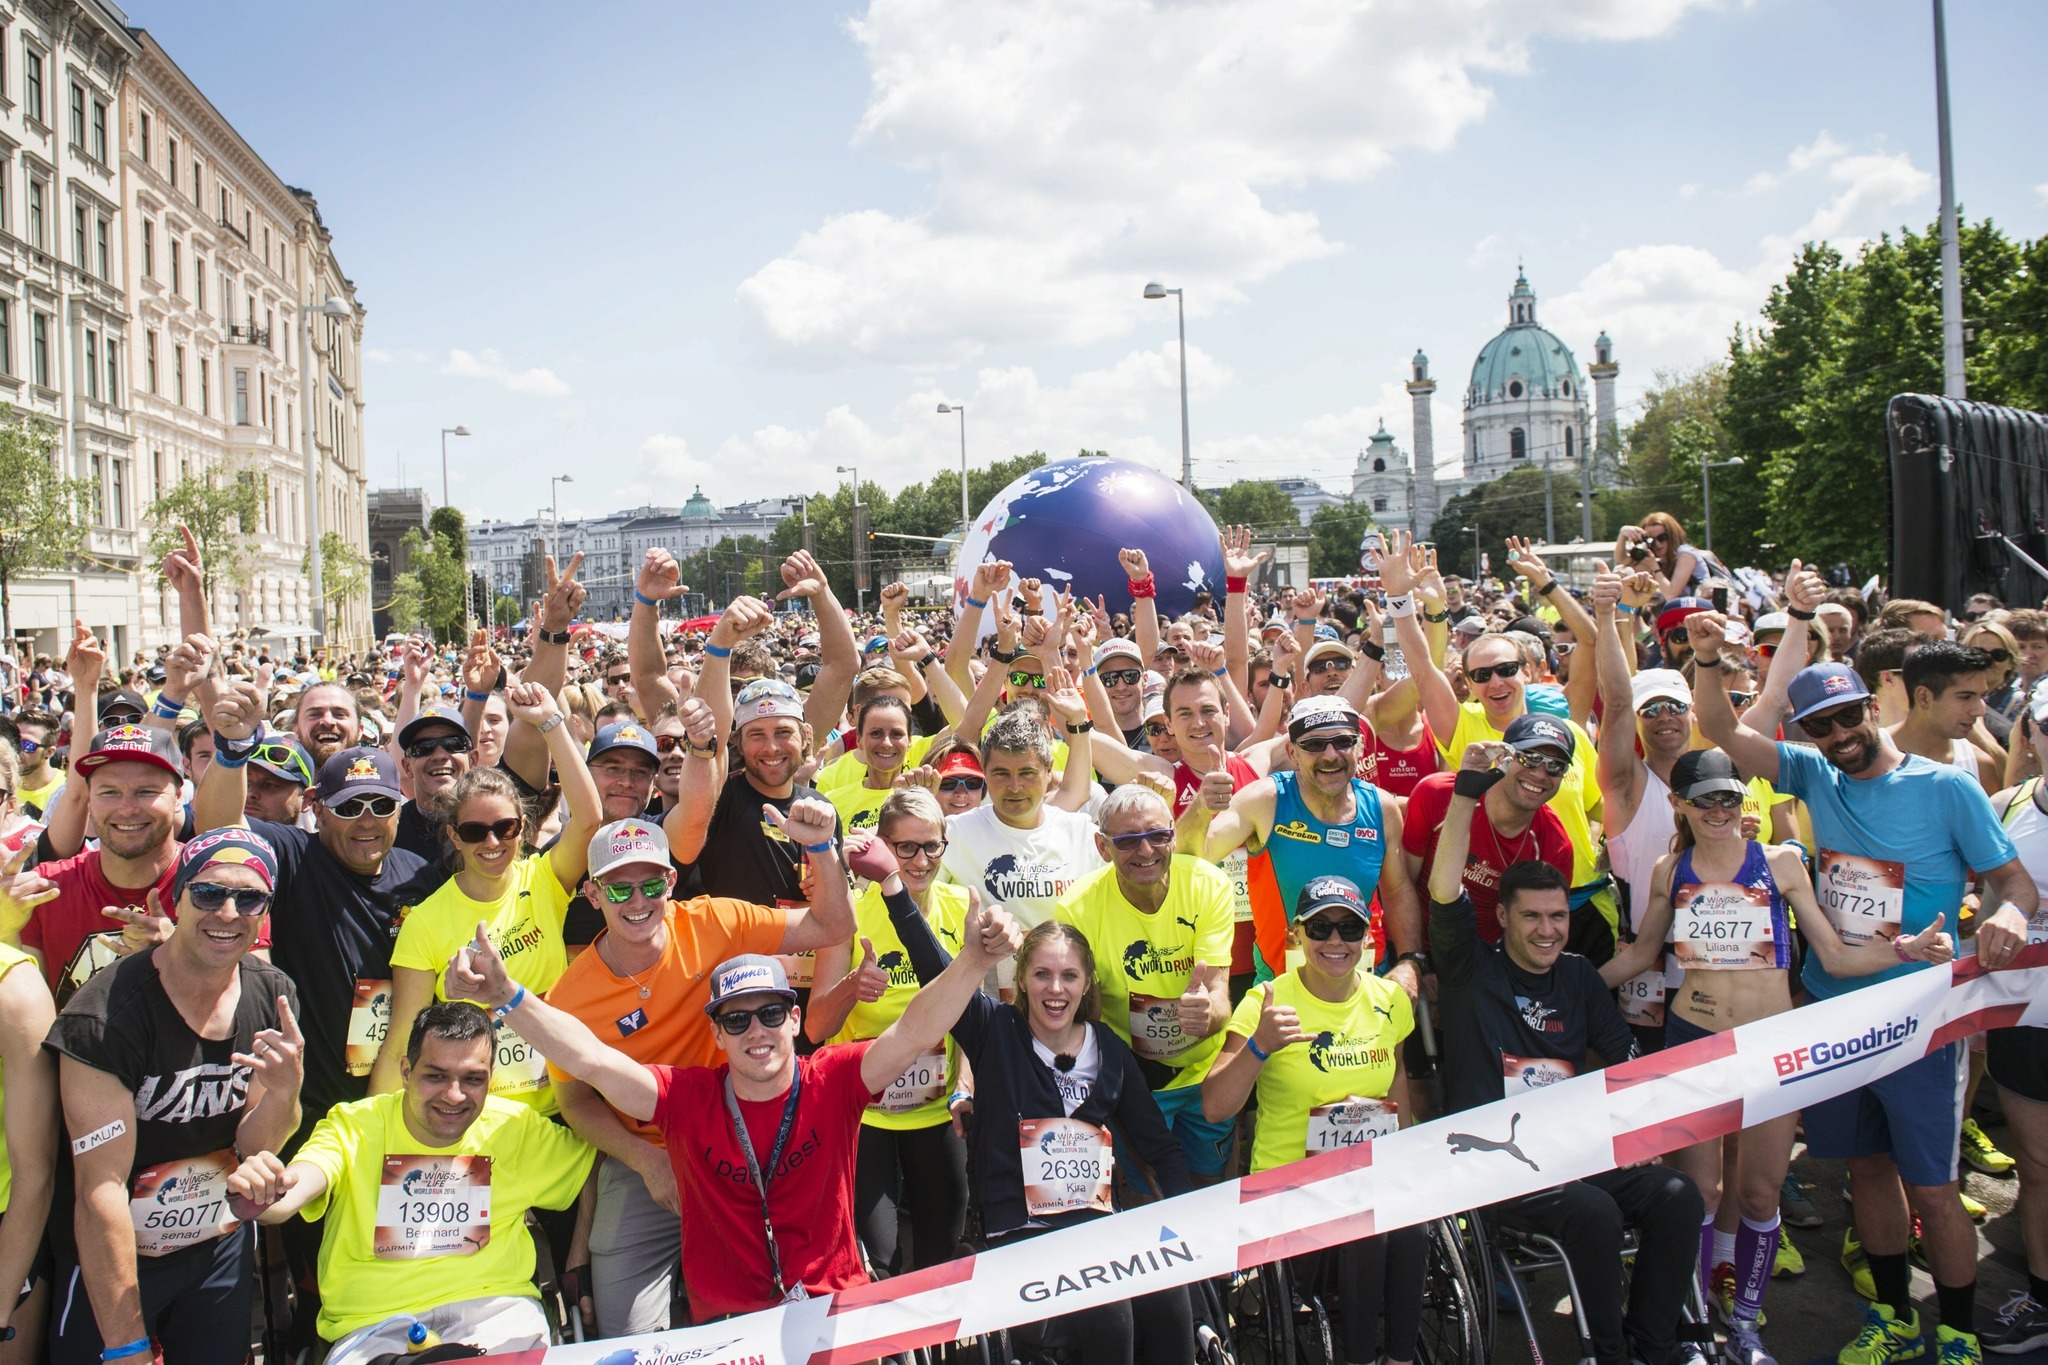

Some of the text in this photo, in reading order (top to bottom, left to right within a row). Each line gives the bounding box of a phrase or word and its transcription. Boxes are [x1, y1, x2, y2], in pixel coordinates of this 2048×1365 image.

[182, 829, 250, 867] Red
[612, 840, 654, 855] Red Bull
[1015, 864, 1048, 873] WINGS
[1840, 868, 1867, 879] WINGS
[1706, 896, 1737, 904] WINGS
[1823, 888, 1887, 918] 107721
[1688, 921, 1753, 939] 24677
[1705, 942, 1740, 952] Liliana
[721, 966, 769, 993] Manner
[1689, 1006, 1715, 1017] GARMIN
[1146, 1024, 1182, 1039] 559
[1168, 1037, 1186, 1047] Karl
[1773, 1015, 1919, 1077] BFGoodrich
[498, 1043, 534, 1066] 067
[894, 1068, 931, 1088] 610
[135, 1063, 253, 1124] VANS
[488, 1083, 516, 1093] ARMIN
[888, 1089, 913, 1100] Karin
[1059, 1086, 1089, 1100] ORLD
[90, 1123, 124, 1147] MUM
[424, 1172, 456, 1180] WINGS
[1041, 1159, 1101, 1181] 26393
[179, 1172, 209, 1187] WINGS
[426, 1179, 446, 1187] LIFE
[182, 1182, 200, 1193] LIFE
[199, 1189, 210, 1198] 2016
[1066, 1183, 1087, 1193] Kira
[1031, 1200, 1064, 1210] GARMIN
[144, 1200, 223, 1229] 56077
[399, 1201, 470, 1224] 13908
[160, 1229, 201, 1241] senad
[406, 1227, 460, 1239] Bernhard
[378, 1244, 416, 1253] GARMIN
[1019, 1241, 1194, 1303] GARMIN
